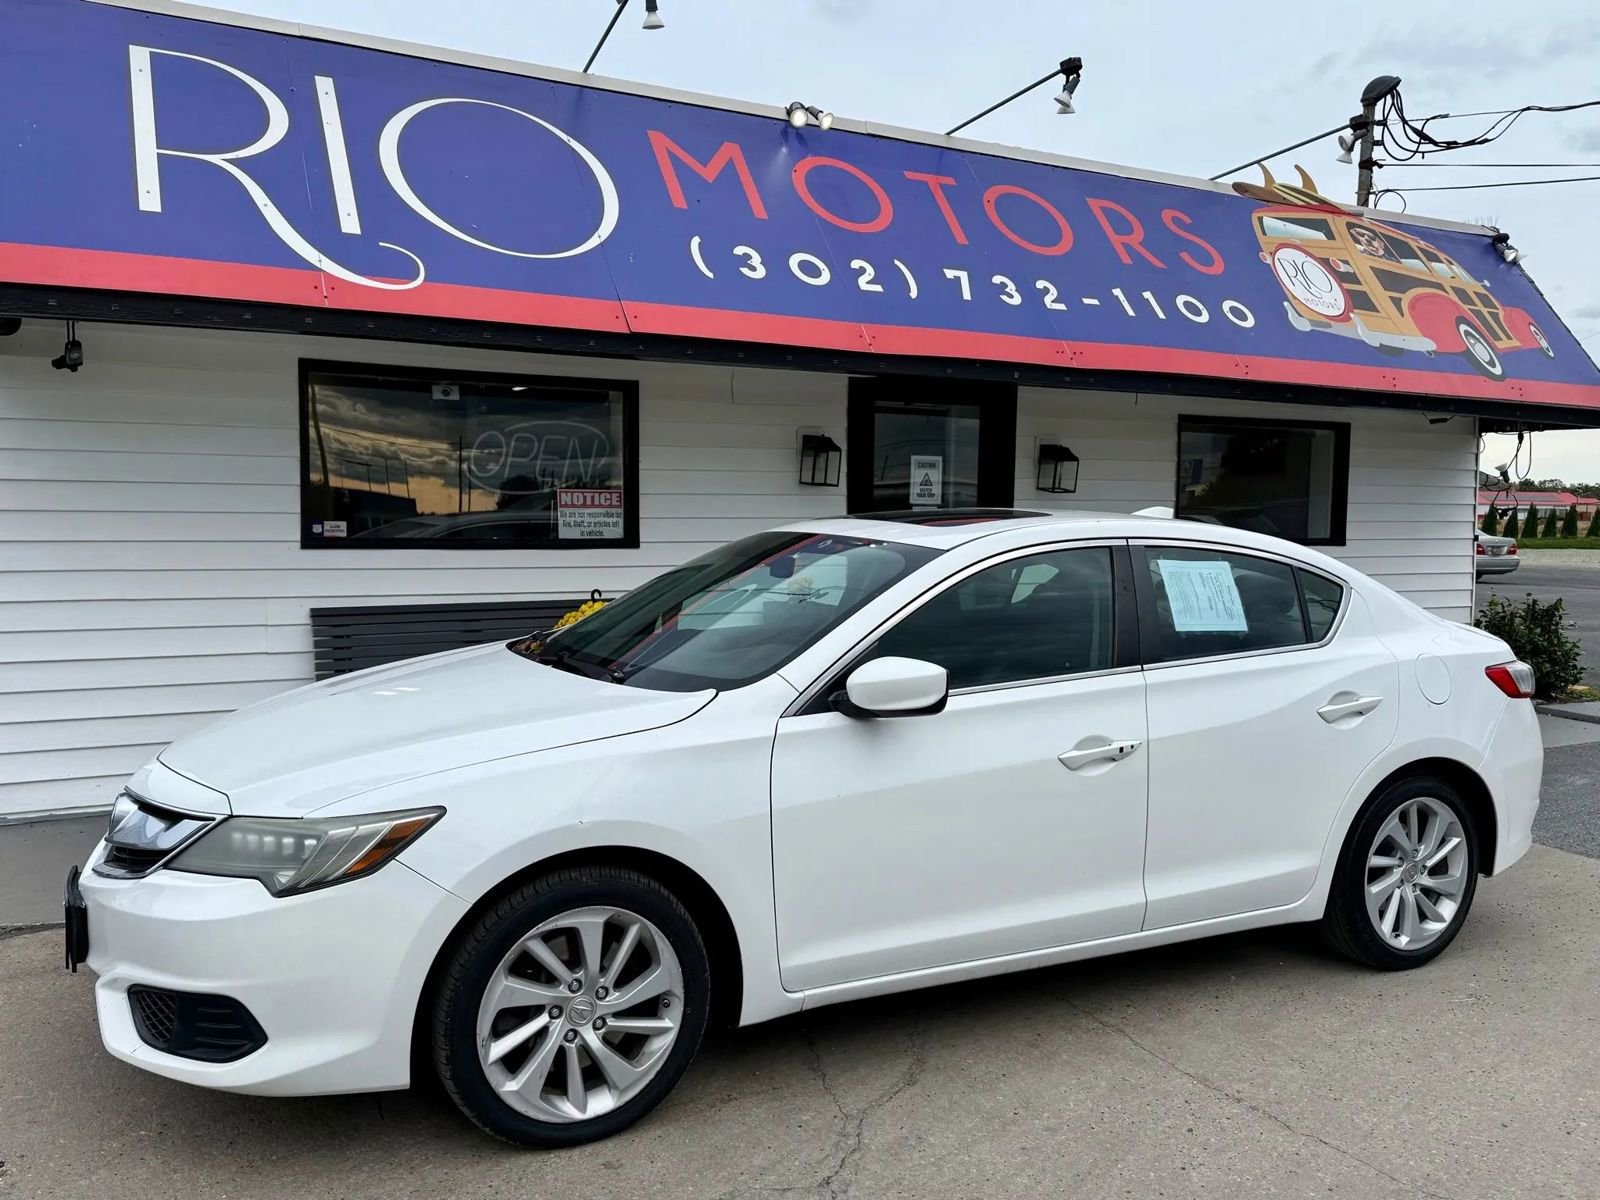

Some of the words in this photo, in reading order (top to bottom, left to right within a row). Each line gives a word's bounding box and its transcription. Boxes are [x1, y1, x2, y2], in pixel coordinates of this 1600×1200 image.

[128, 44, 620, 290] RIO
[647, 130, 1225, 277] MOTORS
[690, 235, 918, 299] (302)
[942, 268, 1256, 329] 732-1100
[1277, 257, 1333, 299] RIO
[471, 430, 600, 483] OPEN
[560, 492, 621, 505] NOTICE
